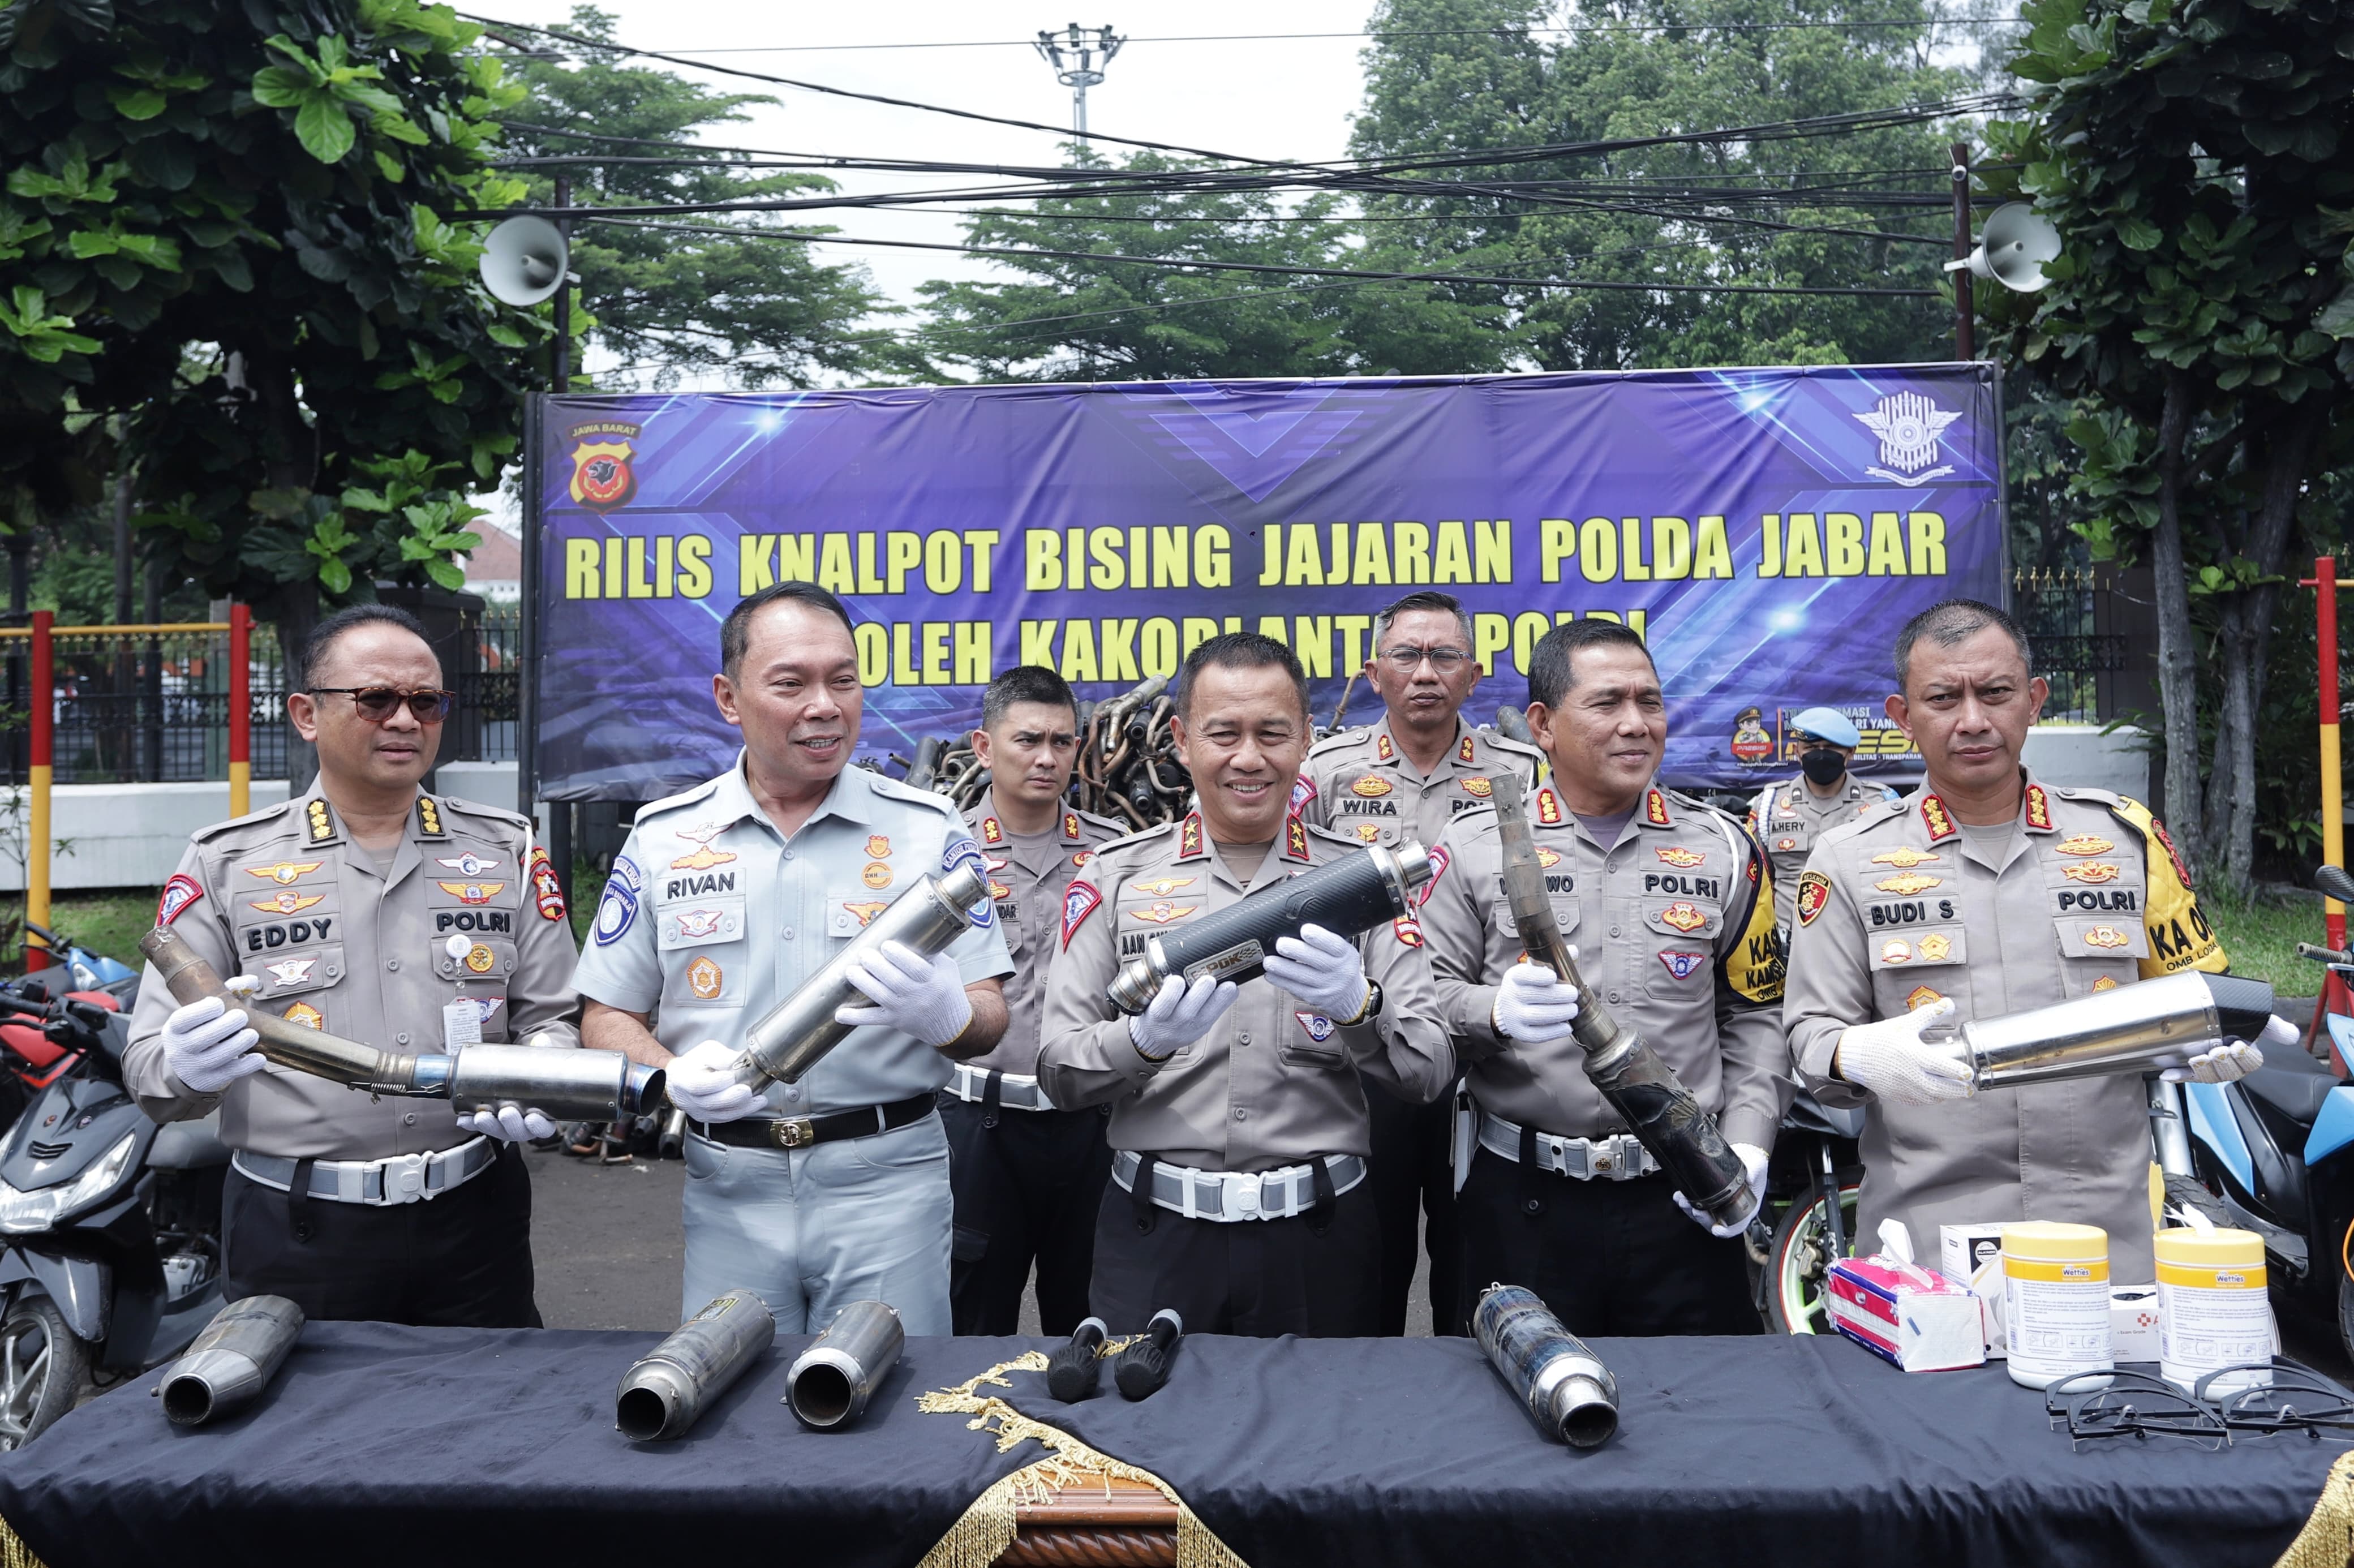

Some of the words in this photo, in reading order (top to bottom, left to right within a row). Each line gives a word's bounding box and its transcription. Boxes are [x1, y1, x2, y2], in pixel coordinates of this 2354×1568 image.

[572, 425, 600, 438] JAWA
[602, 423, 638, 436] BARAT
[566, 536, 712, 599] RILIS
[741, 531, 999, 596] KNALPOT
[1026, 525, 1231, 590] BISING
[1258, 521, 1511, 586] JAJARAN
[1541, 517, 1731, 582] POLDA
[1759, 513, 1947, 577] JABAR
[854, 621, 991, 686] OLEH
[1342, 800, 1397, 816] WIRA
[1771, 822, 1806, 834] A.HERY
[944, 845, 965, 866] KANTOR
[667, 871, 735, 900] RIVAN
[1644, 874, 1719, 899] POLRI
[1803, 874, 1827, 885] RESKRIM
[2057, 890, 2136, 911] POLRI
[436, 911, 510, 933] POLRI
[1870, 901, 1926, 926] BUDI
[1938, 899, 1954, 919] S
[246, 918, 332, 951] EDDY
[1122, 934, 1145, 956] AAN
[2149, 918, 2193, 961] KA
[2166, 956, 2193, 971] OMB
